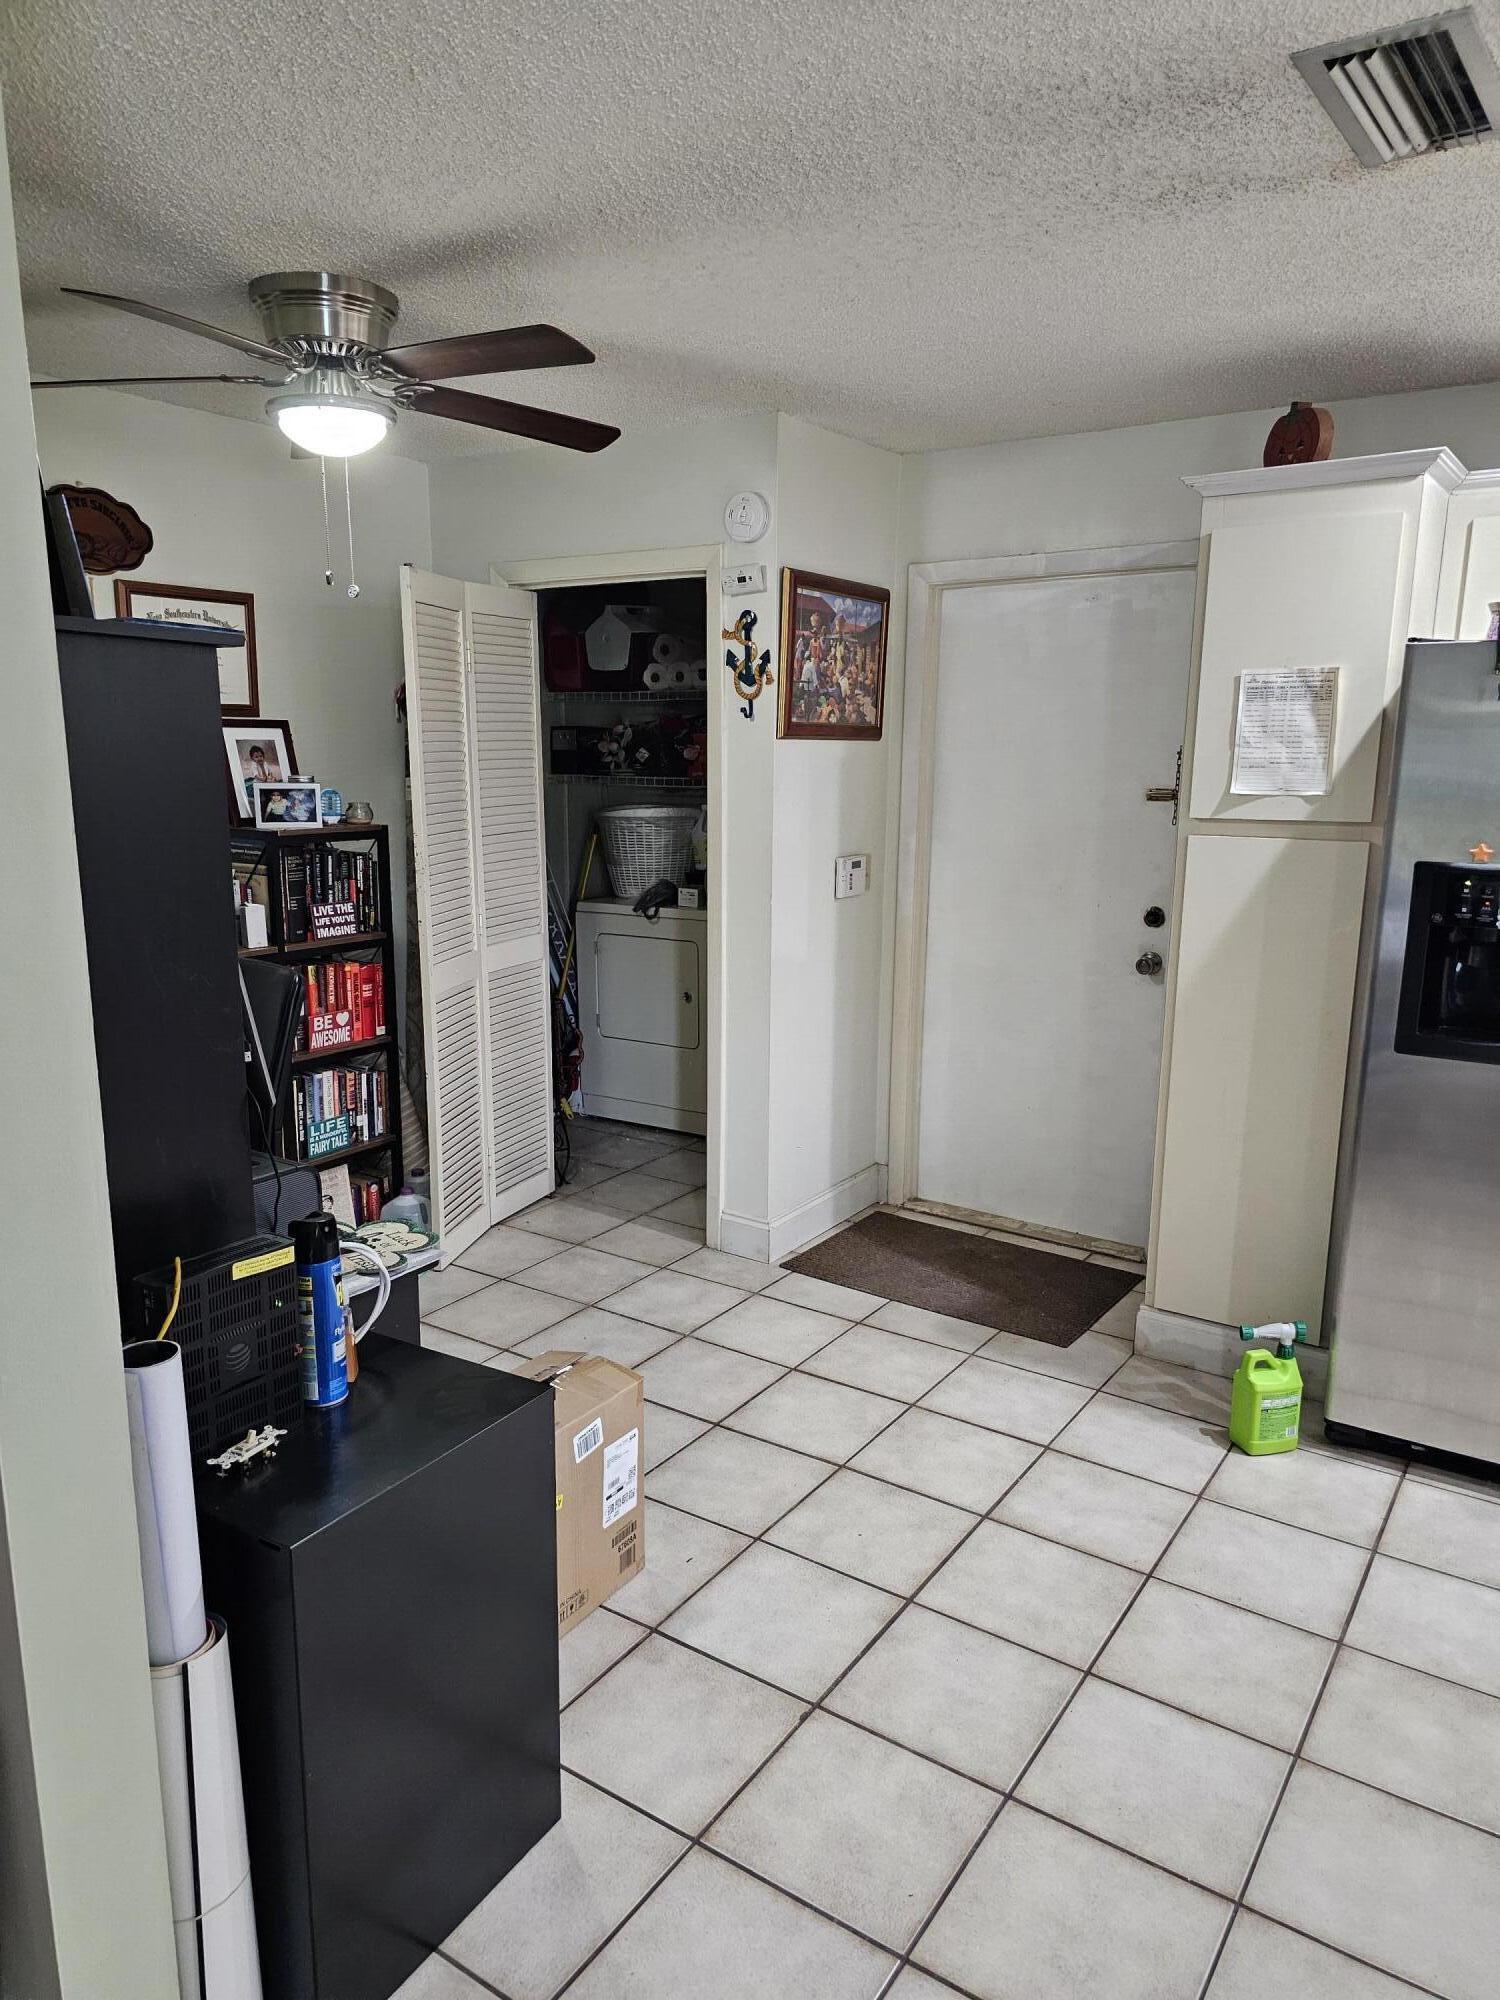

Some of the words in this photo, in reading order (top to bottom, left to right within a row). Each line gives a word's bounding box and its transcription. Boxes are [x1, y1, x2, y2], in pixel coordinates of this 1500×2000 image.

[313, 904, 335, 917] LIVE
[335, 902, 354, 914] THE
[315, 917, 331, 926] LIFE
[331, 914, 356, 924] YOU'VE
[317, 924, 357, 939] IMAGINE
[313, 1014, 333, 1031] BE
[311, 1025, 351, 1049] AWESOME
[310, 1116, 346, 1137] LIFE
[310, 1139, 330, 1155] FAIRY
[331, 1132, 348, 1149] TALE
